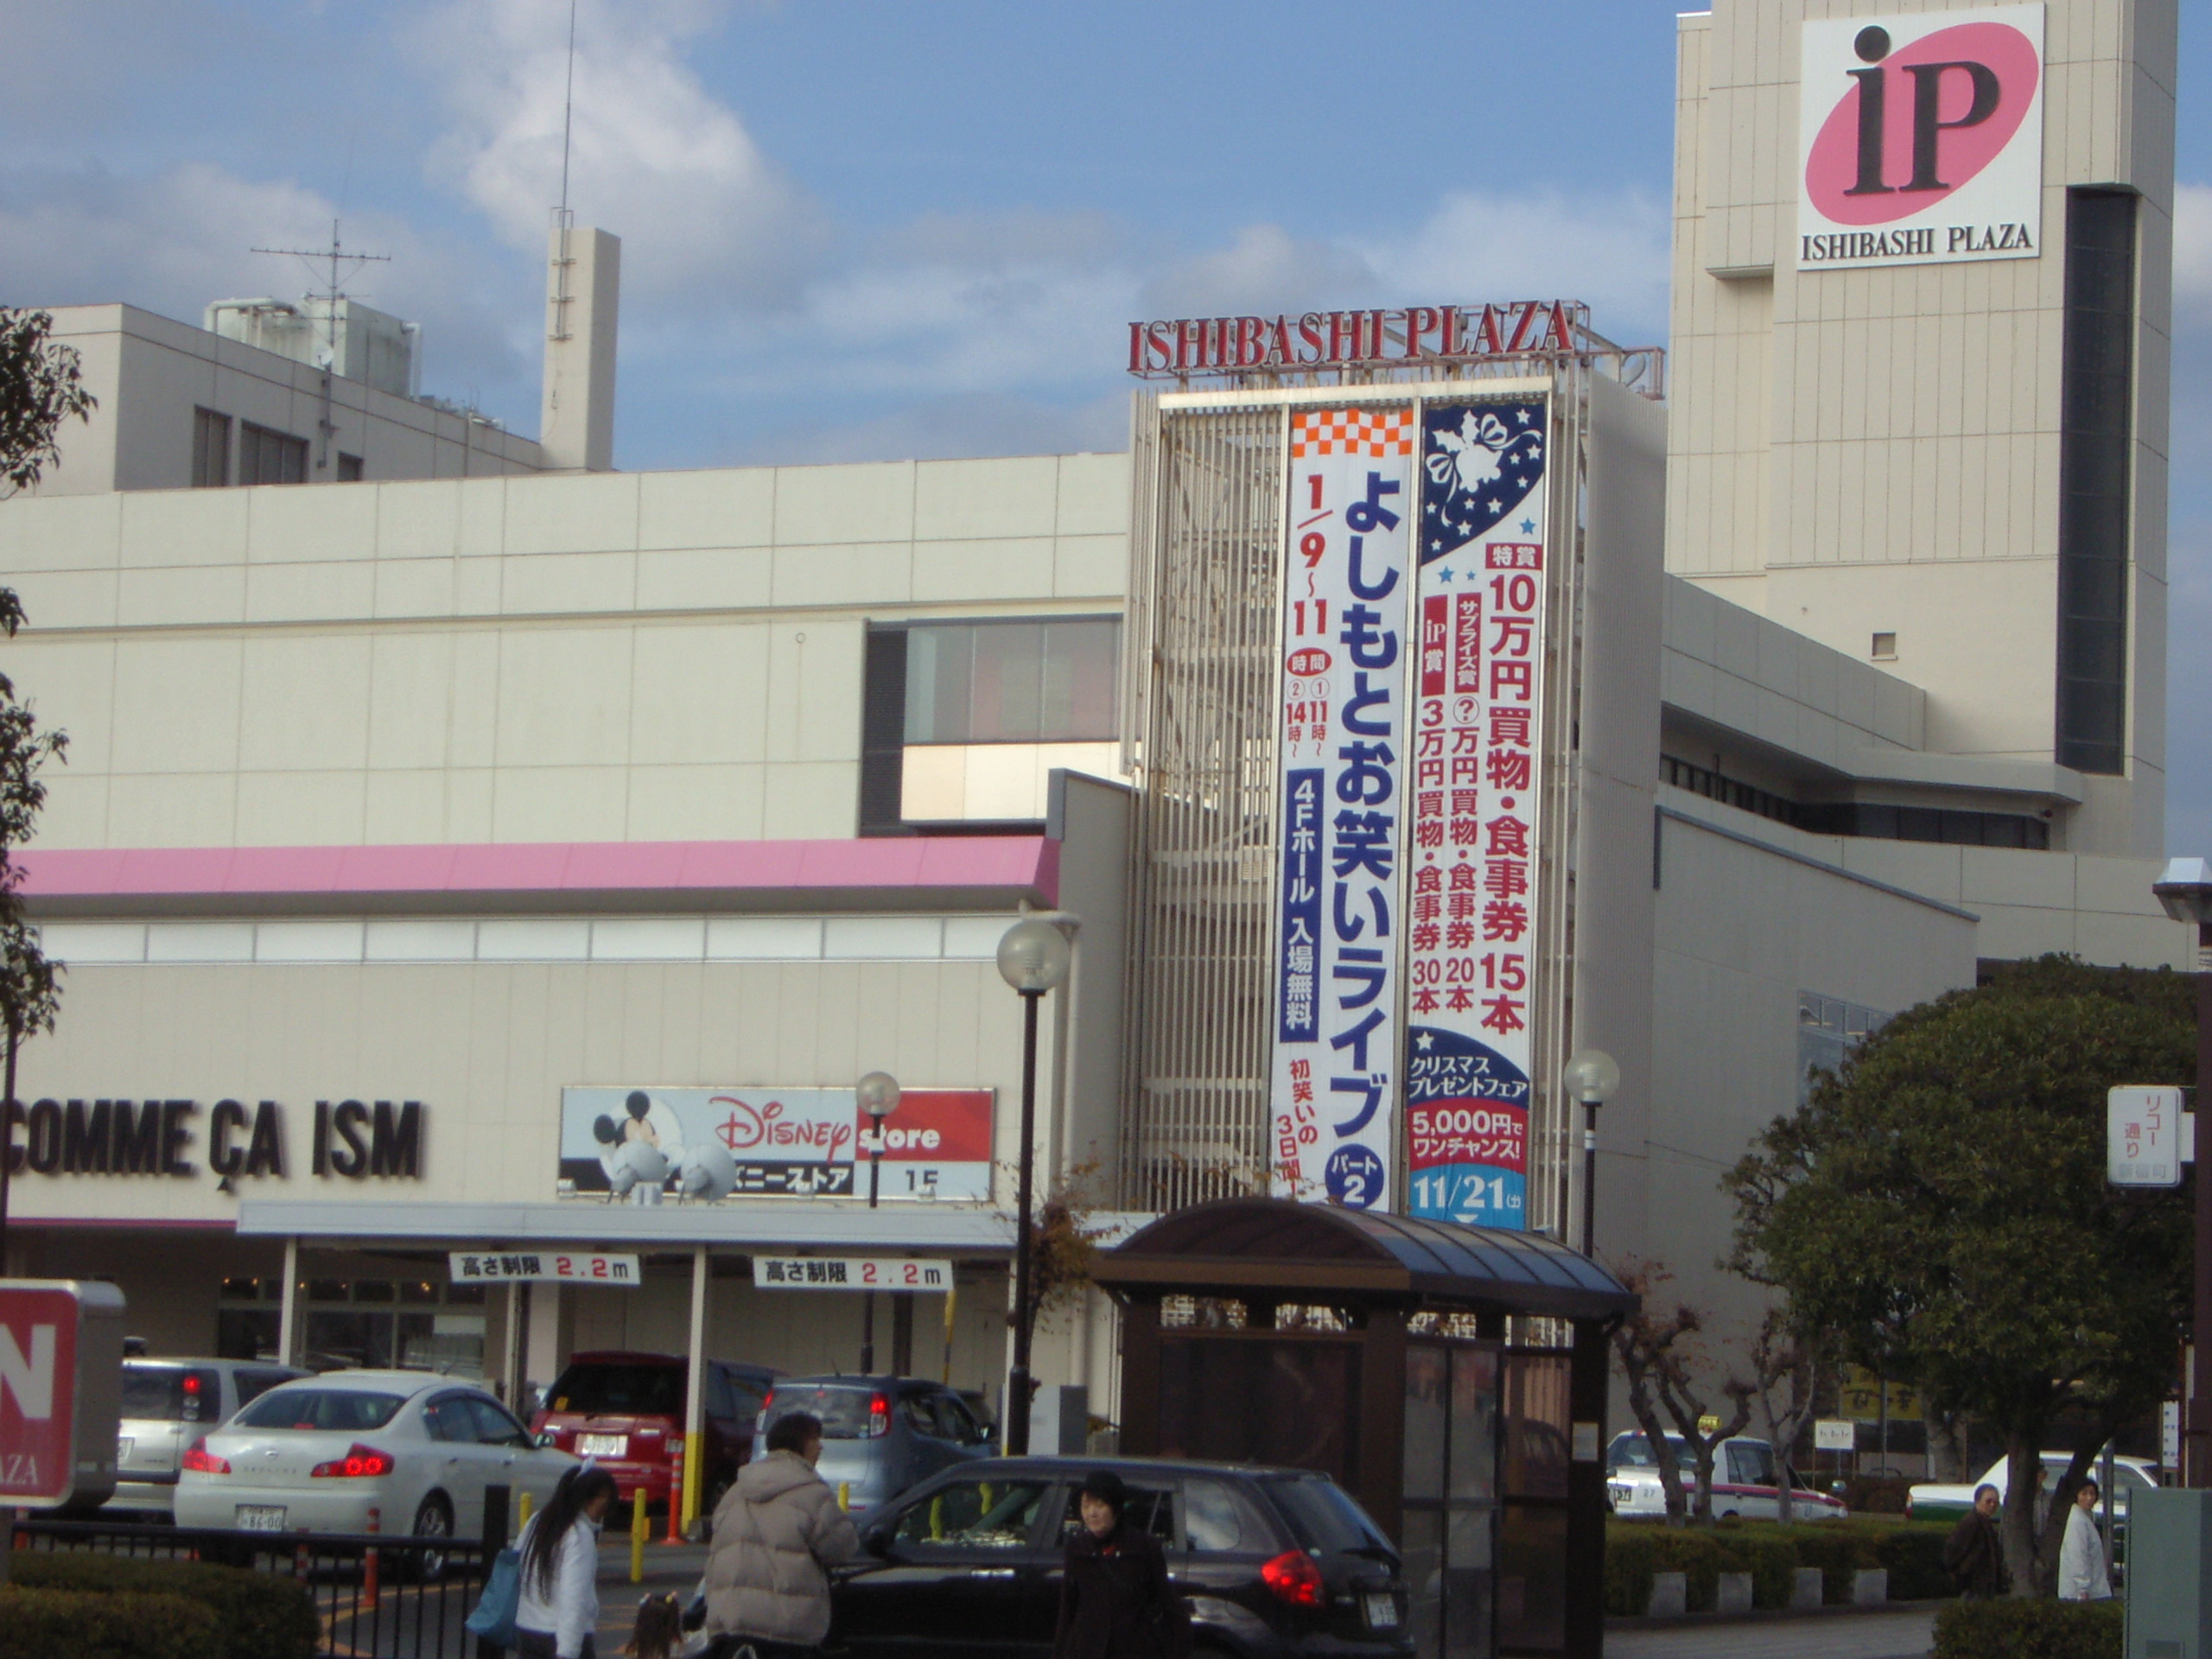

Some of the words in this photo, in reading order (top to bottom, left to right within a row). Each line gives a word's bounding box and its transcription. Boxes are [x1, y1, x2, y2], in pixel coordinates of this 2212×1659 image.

[1843, 25, 2000, 197] iP
[1802, 228, 1935, 261] ISHIBASHI
[1947, 223, 2033, 252] PLAZA
[1127, 308, 1386, 373] ISHIBASHI
[1403, 299, 1576, 359] PLAZA
[1492, 545, 1535, 567] 特賞
[1292, 654, 1326, 672] 時間
[1330, 471, 1402, 1139] よしもとお笑いライブ
[1287, 917, 1315, 1030] 入場無料
[1410, 1056, 1491, 1077] クリスマス
[1290, 1058, 1319, 1144] 初笑いの
[1408, 1077, 1528, 1099] プレゼントフェア
[1413, 1109, 1523, 1136] 5,000円で
[2146, 1096, 2161, 1146] リコー
[0, 1099, 194, 1174] COMME
[312, 1100, 421, 1176] ISM
[1414, 1137, 1521, 1160] ワンチャンス!
[1332, 1154, 1378, 1176] パート
[1343, 1174, 1365, 1204] 2
[461, 1255, 542, 1276] 高さ制限
[766, 1260, 848, 1282] 高さ制限
